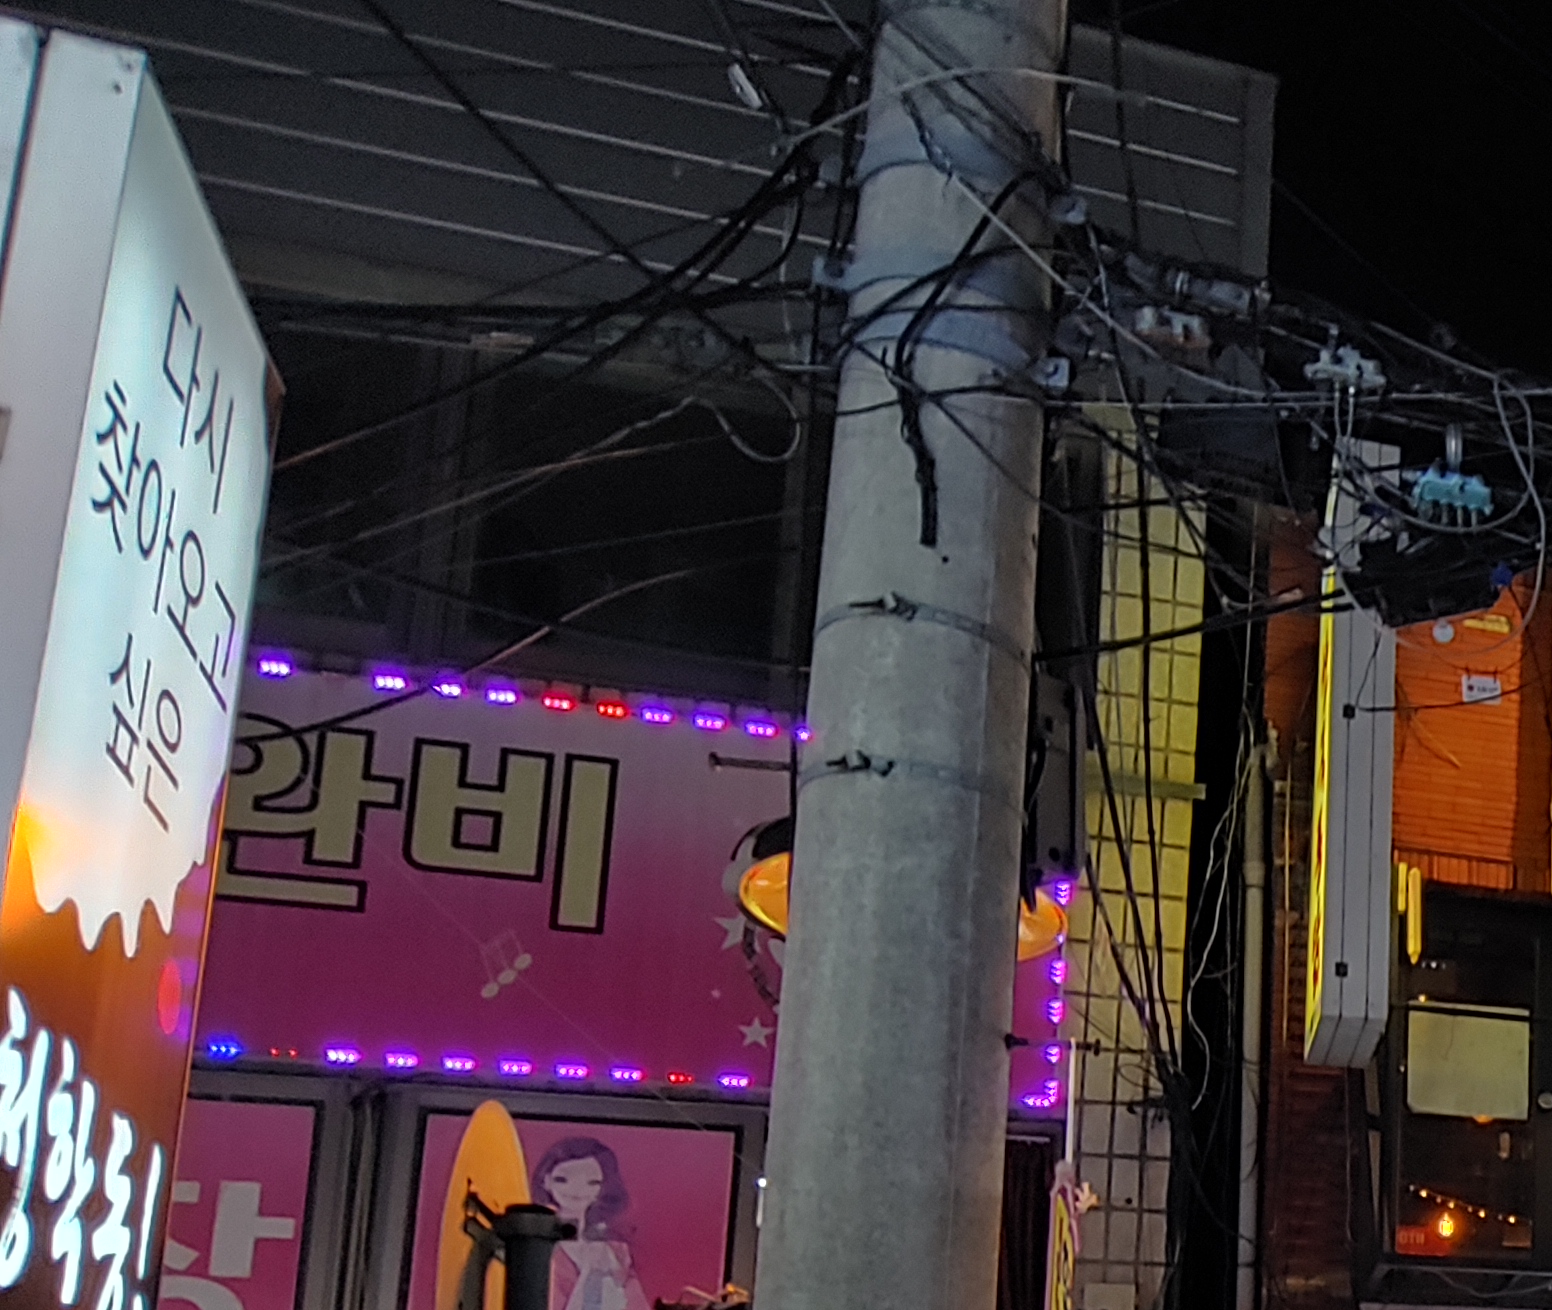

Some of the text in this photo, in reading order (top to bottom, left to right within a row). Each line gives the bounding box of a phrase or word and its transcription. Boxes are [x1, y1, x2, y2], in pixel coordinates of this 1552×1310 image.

[162, 286, 233, 514] 다시
[92, 380, 237, 714] 찾아오고
[106, 632, 184, 833] 싶은
